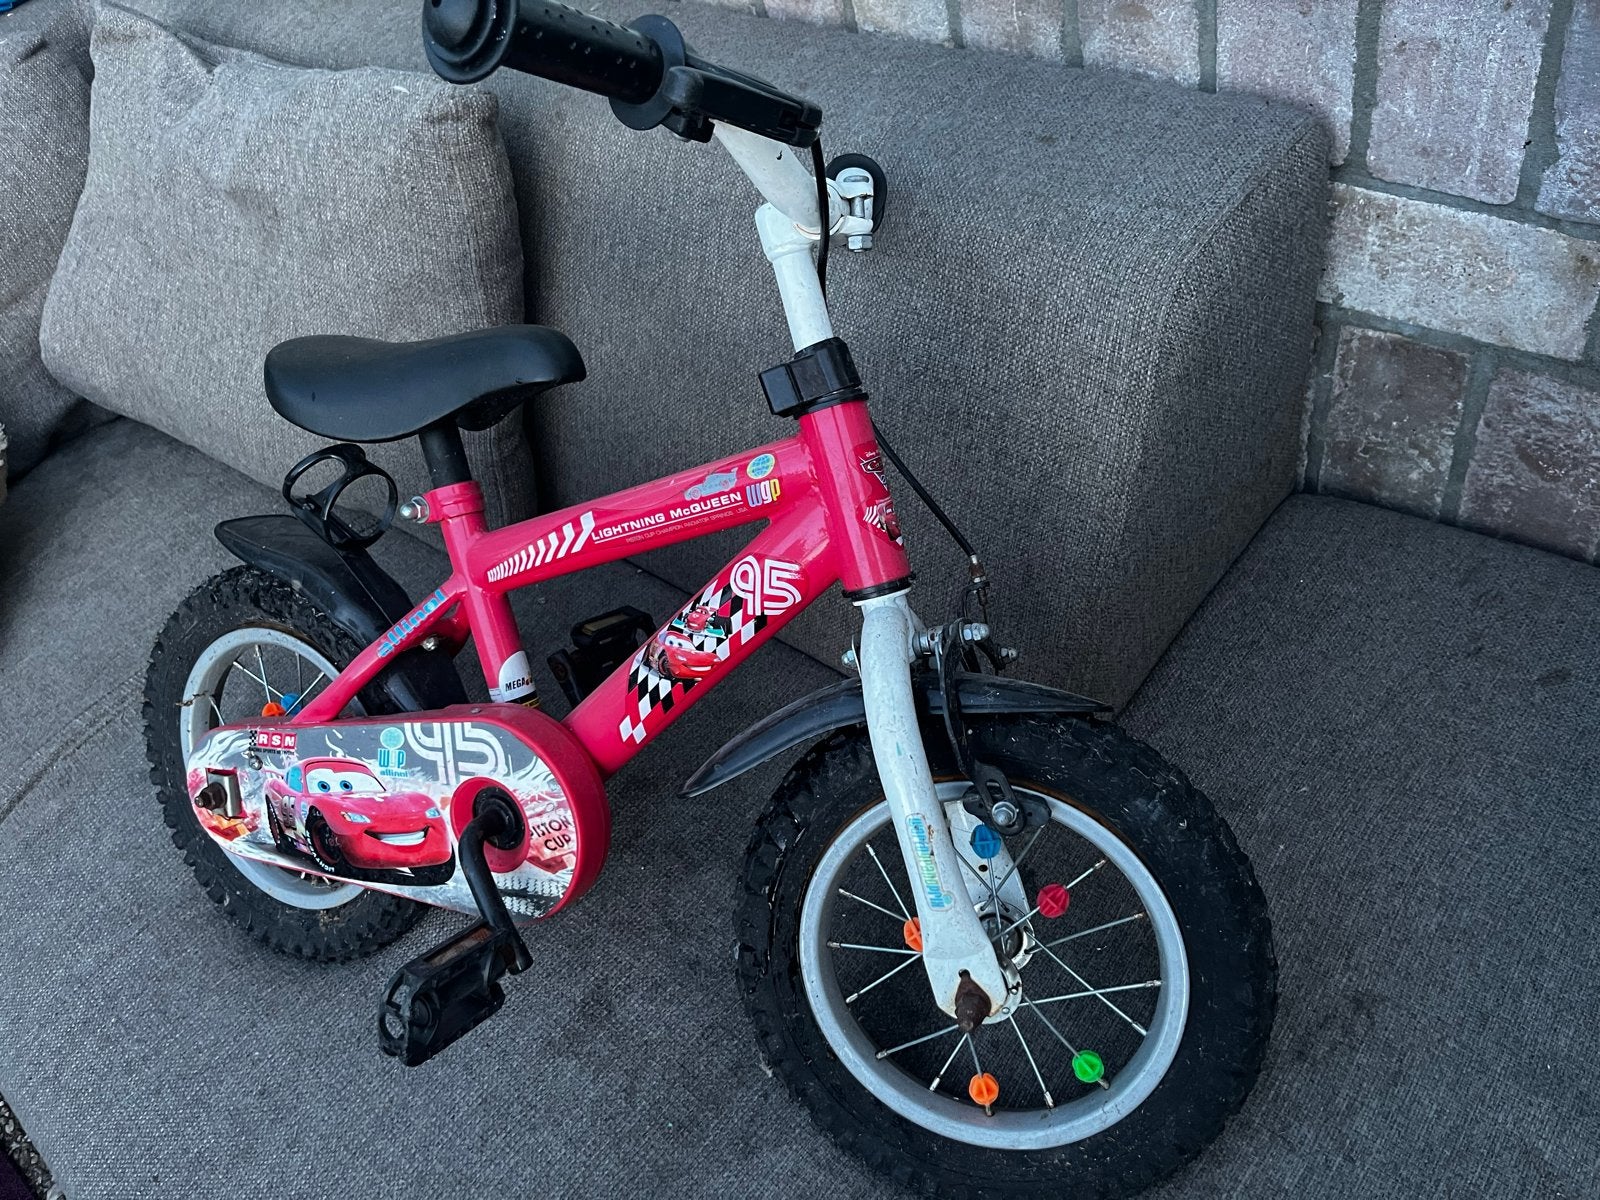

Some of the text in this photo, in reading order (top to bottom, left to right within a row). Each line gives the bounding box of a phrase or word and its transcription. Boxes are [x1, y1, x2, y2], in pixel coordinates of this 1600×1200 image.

[591, 491, 742, 541] LIGHTNING McQUEEN
[729, 555, 801, 616] 95
[377, 588, 447, 658] allinol
[258, 733, 295, 746] RSN
[530, 815, 573, 839] ISTON
[544, 834, 571, 851] CUP
